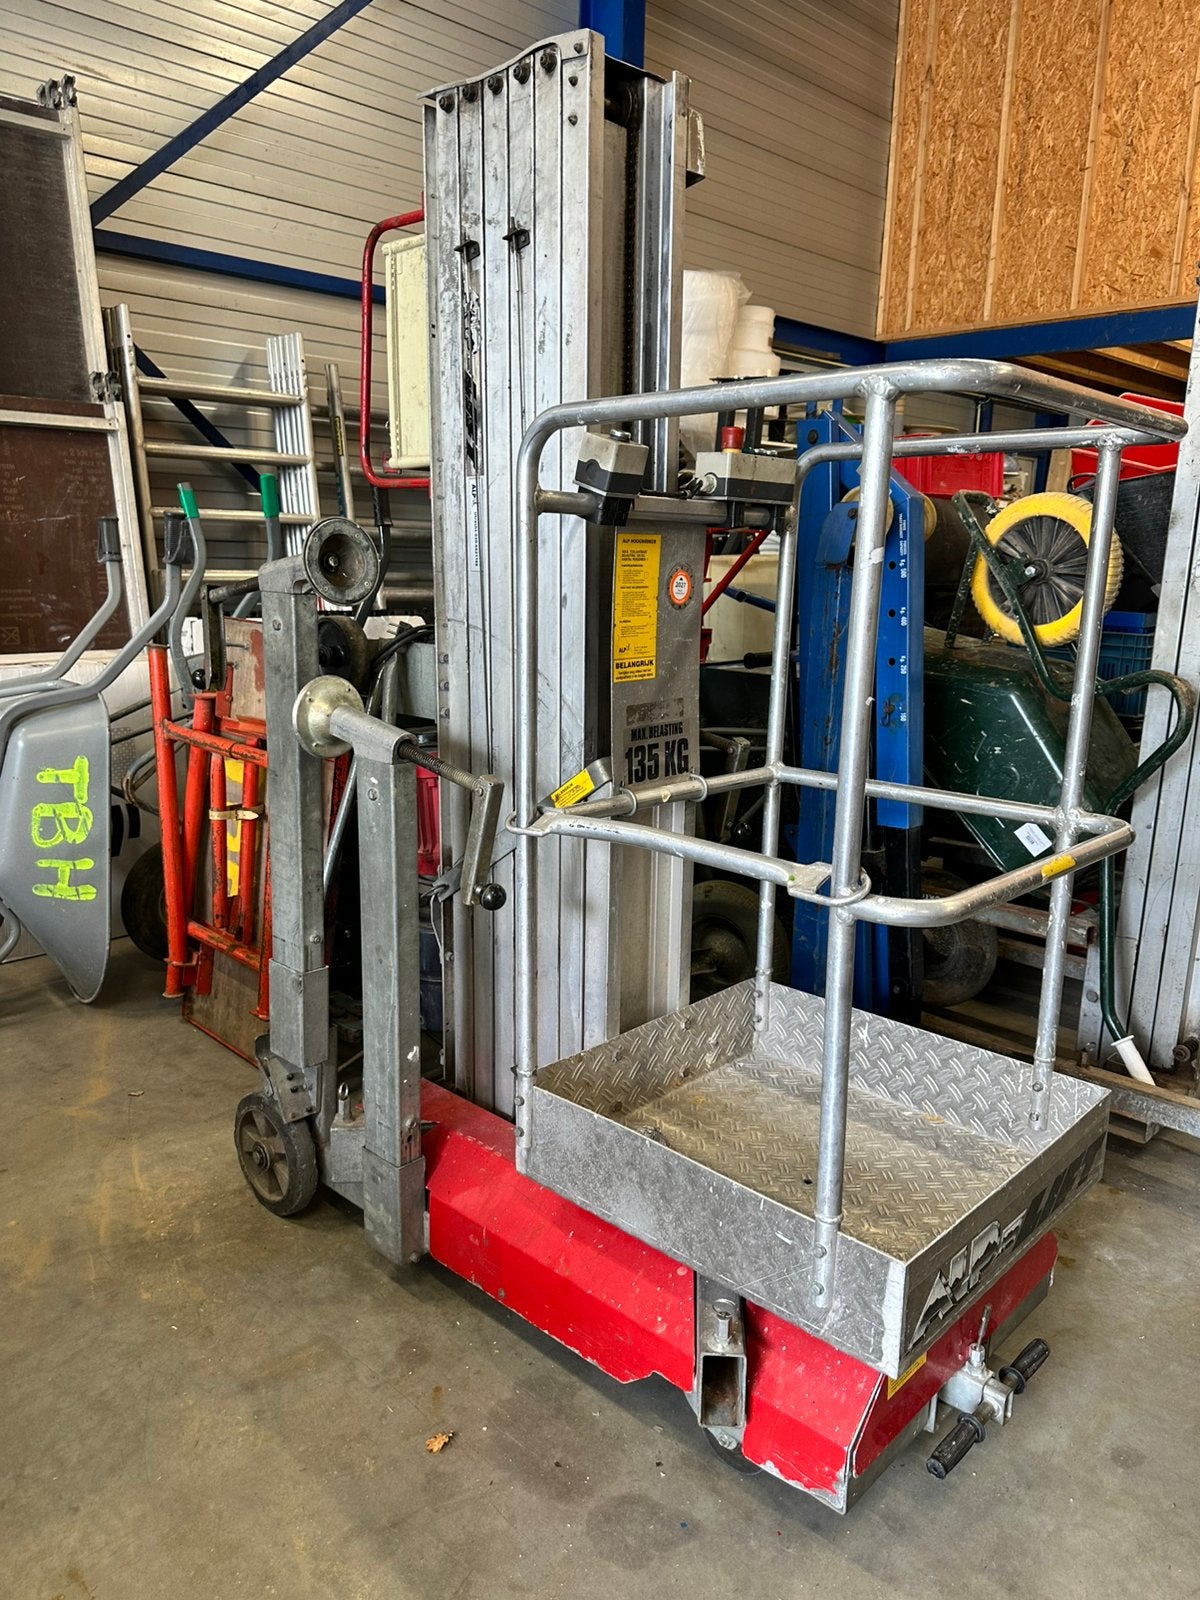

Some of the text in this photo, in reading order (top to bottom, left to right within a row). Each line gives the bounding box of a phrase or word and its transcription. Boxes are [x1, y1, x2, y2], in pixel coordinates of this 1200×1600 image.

[615, 659, 654, 670] BELANGRIJK
[631, 722, 684, 742] MAX. BELASTING
[625, 738, 689, 785] 135 KG
[31, 754, 97, 901] TBH
